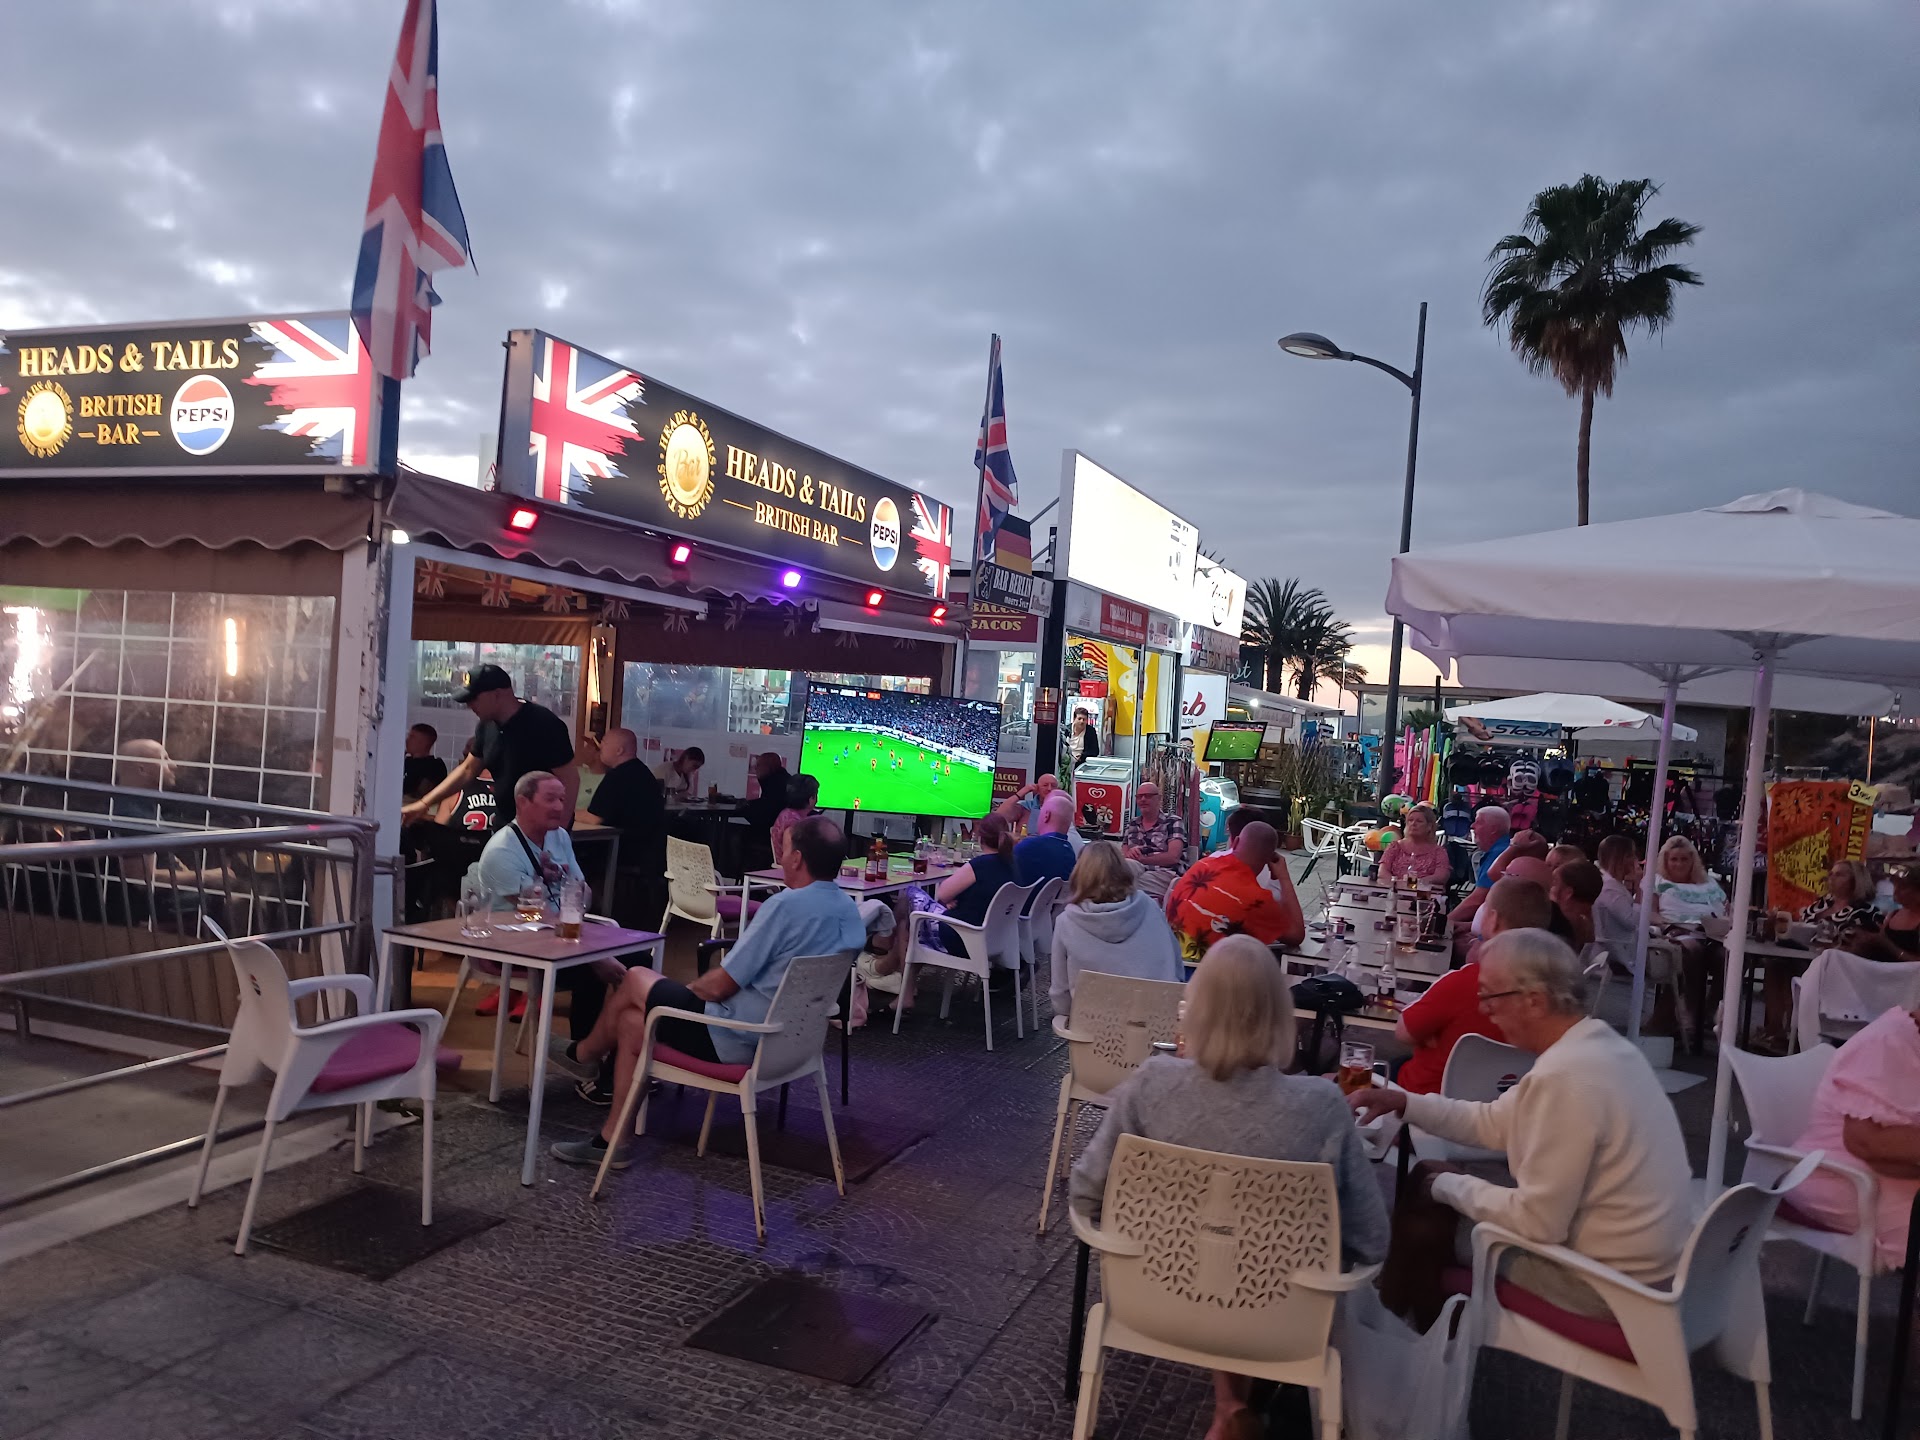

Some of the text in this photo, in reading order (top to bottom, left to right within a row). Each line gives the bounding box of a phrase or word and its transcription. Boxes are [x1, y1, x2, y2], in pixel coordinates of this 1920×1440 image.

[18, 338, 240, 377] HEADS & TAILS
[79, 394, 163, 418] BRITISH
[177, 406, 229, 423] PEPSI
[97, 423, 140, 445] BAR
[659, 410, 717, 465] HEADS & TAILS
[725, 444, 866, 524] HEADS & TAILS
[755, 501, 839, 547] BRITISH BAR
[873, 523, 898, 545] PEPSI
[993, 568, 1033, 598] BAR BERLIN
